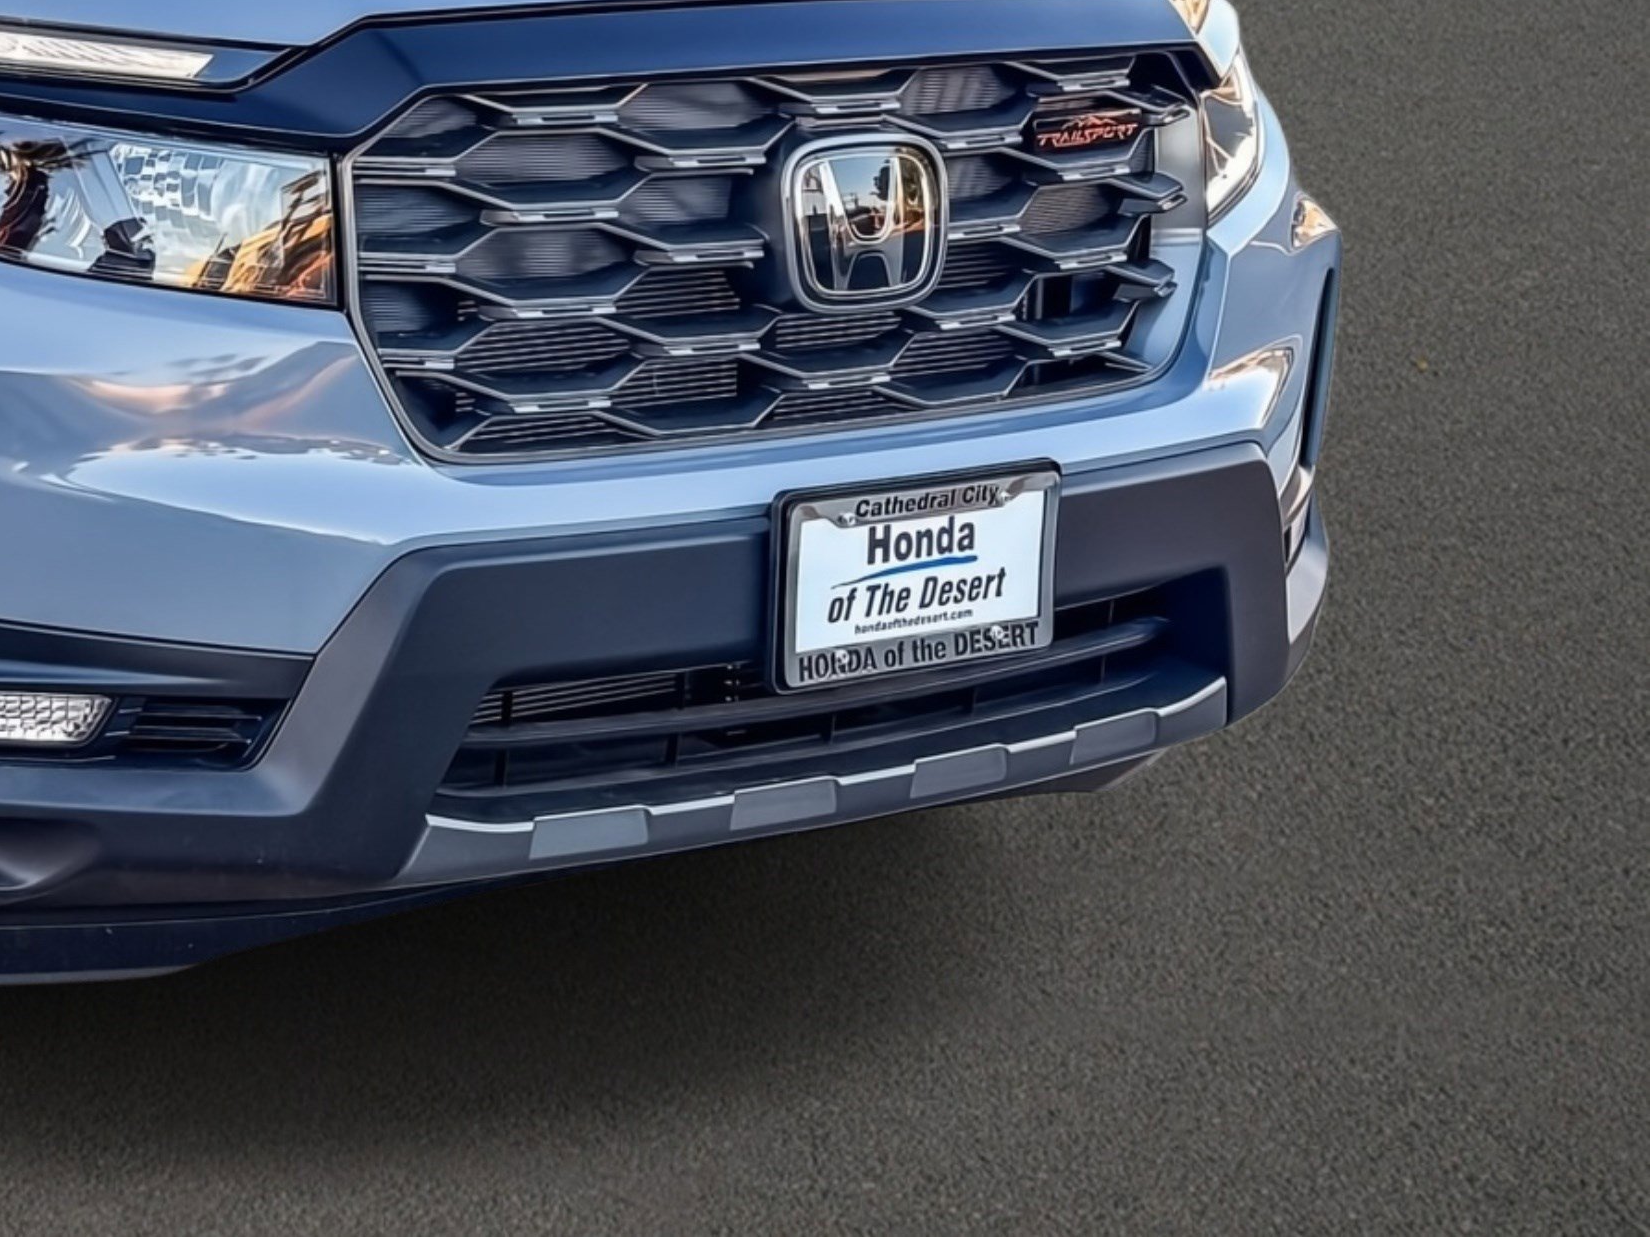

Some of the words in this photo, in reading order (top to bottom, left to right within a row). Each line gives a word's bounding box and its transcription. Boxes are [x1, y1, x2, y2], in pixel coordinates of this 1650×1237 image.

[855, 488, 956, 518] Cathedral
[961, 483, 1001, 505] City
[866, 515, 975, 565] Honda
[827, 586, 858, 624] of
[864, 581, 912, 619] The
[918, 566, 1007, 610] Desert
[853, 608, 974, 635] hondaofthedesert.com
[799, 646, 878, 682] HONDA
[883, 640, 905, 668] of
[911, 637, 947, 663] the
[953, 620, 1039, 657] DESERT
